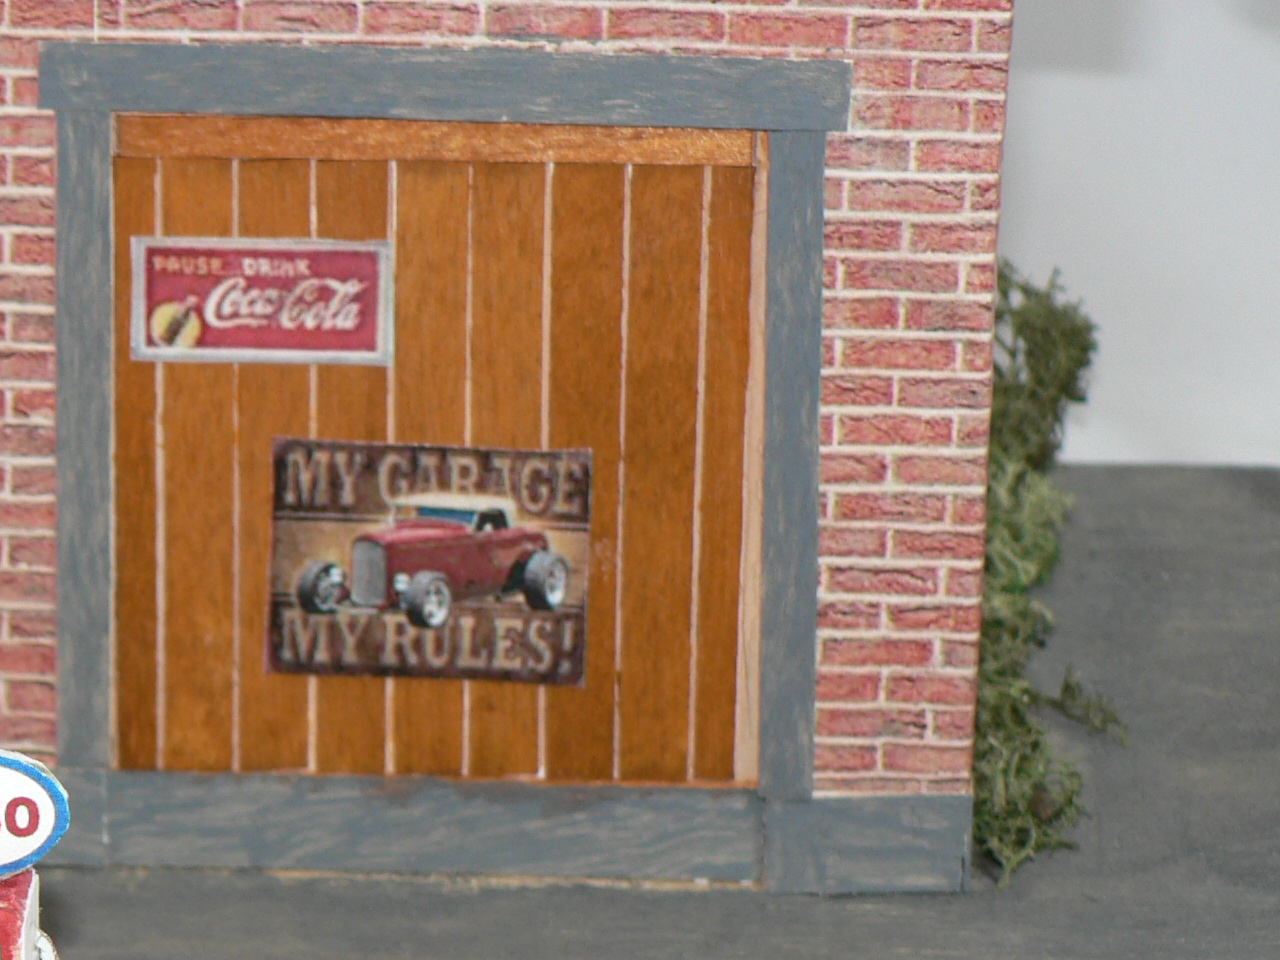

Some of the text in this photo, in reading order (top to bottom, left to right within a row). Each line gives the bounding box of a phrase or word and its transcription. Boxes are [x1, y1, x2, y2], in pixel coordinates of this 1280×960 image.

[284, 448, 586, 514] MY GARAGE
[281, 609, 577, 675] MY RULES!
